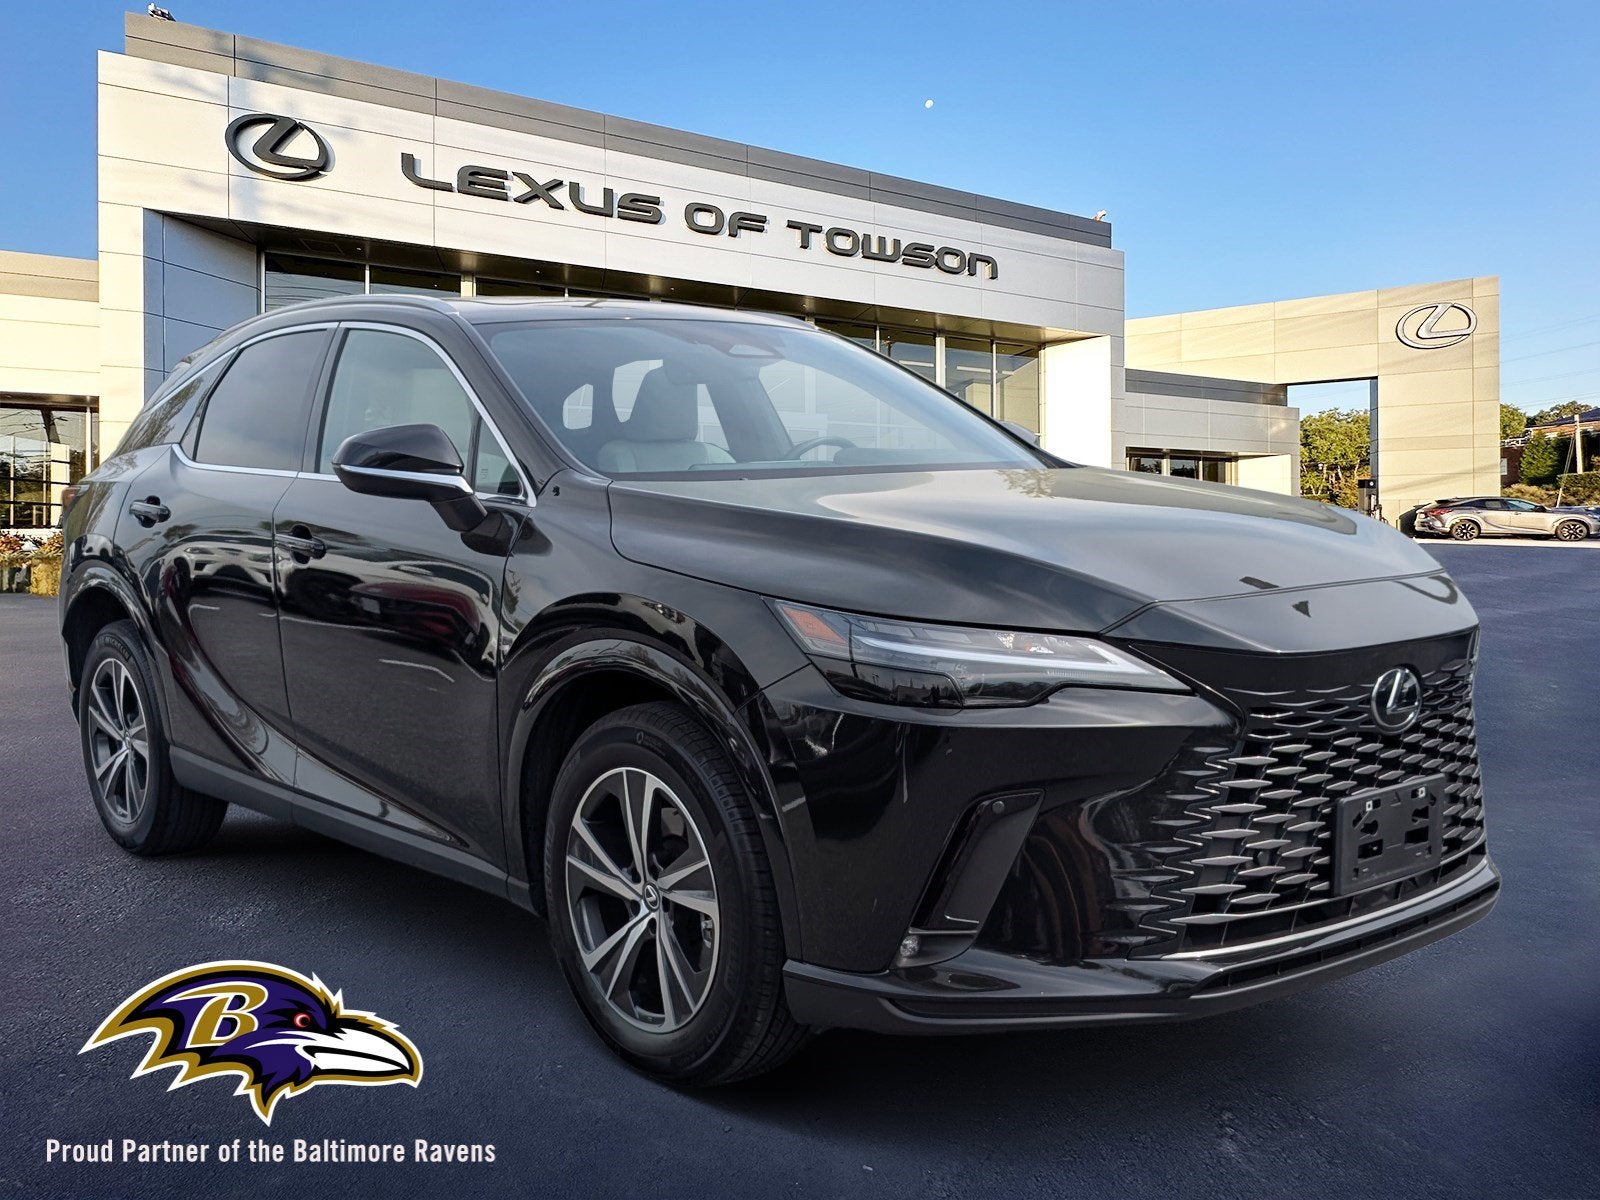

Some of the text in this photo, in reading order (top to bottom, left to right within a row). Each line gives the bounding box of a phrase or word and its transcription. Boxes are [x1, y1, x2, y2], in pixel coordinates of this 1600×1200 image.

[401, 152, 999, 281] LEXUS OF TOWSON
